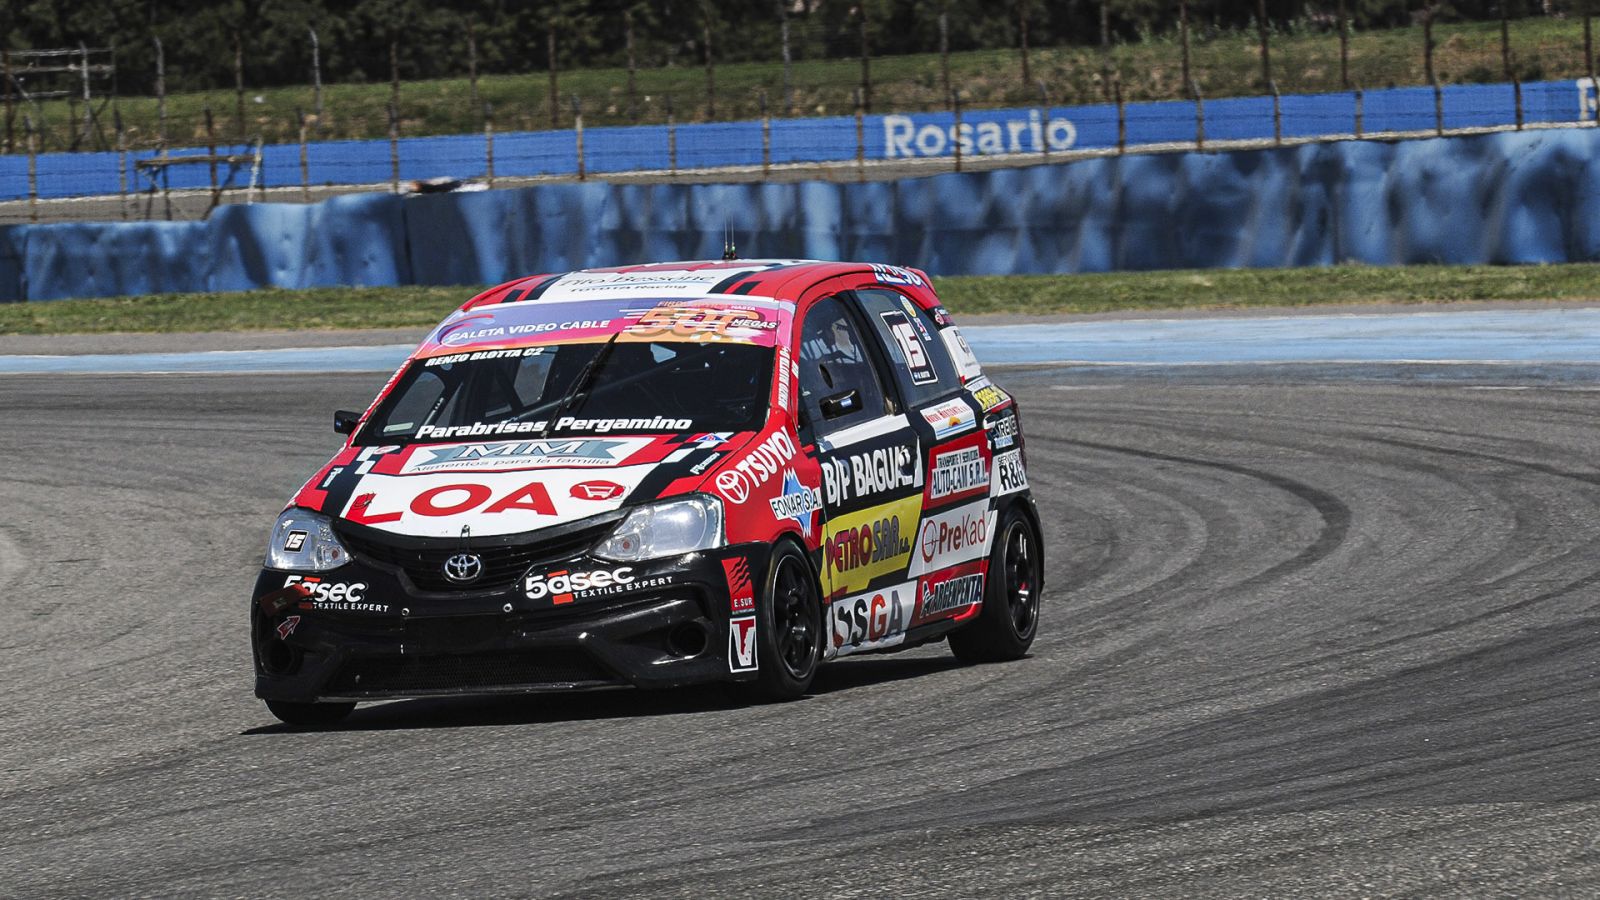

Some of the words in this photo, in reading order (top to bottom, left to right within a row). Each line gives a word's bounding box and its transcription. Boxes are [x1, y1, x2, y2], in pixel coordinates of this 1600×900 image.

[884, 109, 1077, 157] Rosario
[448, 327, 504, 342] CALETA
[508, 322, 556, 334] VIDEO
[559, 319, 611, 330] CABLE
[731, 318, 778, 329] MEGAS
[892, 322, 926, 368] 15
[424, 354, 471, 367] RENZO
[473, 349, 523, 361] BLOTTA
[414, 420, 548, 439] Parabrisas
[554, 416, 693, 433] Pergamino
[452, 441, 590, 459] MM
[735, 426, 796, 488] TSUYOI
[408, 460, 490, 473] Alimentos
[493, 458, 532, 467] para
[556, 456, 610, 465] familia
[821, 456, 851, 507] B/P
[345, 482, 558, 524] LOA
[772, 492, 802, 518] FONAR
[285, 533, 306, 549] 15
[939, 510, 986, 554] PreKad
[525, 567, 635, 600] 5asec
[573, 585, 623, 598] TEXTILE
[626, 576, 673, 590] EXPERT
[313, 602, 349, 610] TEXTILE
[351, 603, 389, 613] EXPERT
